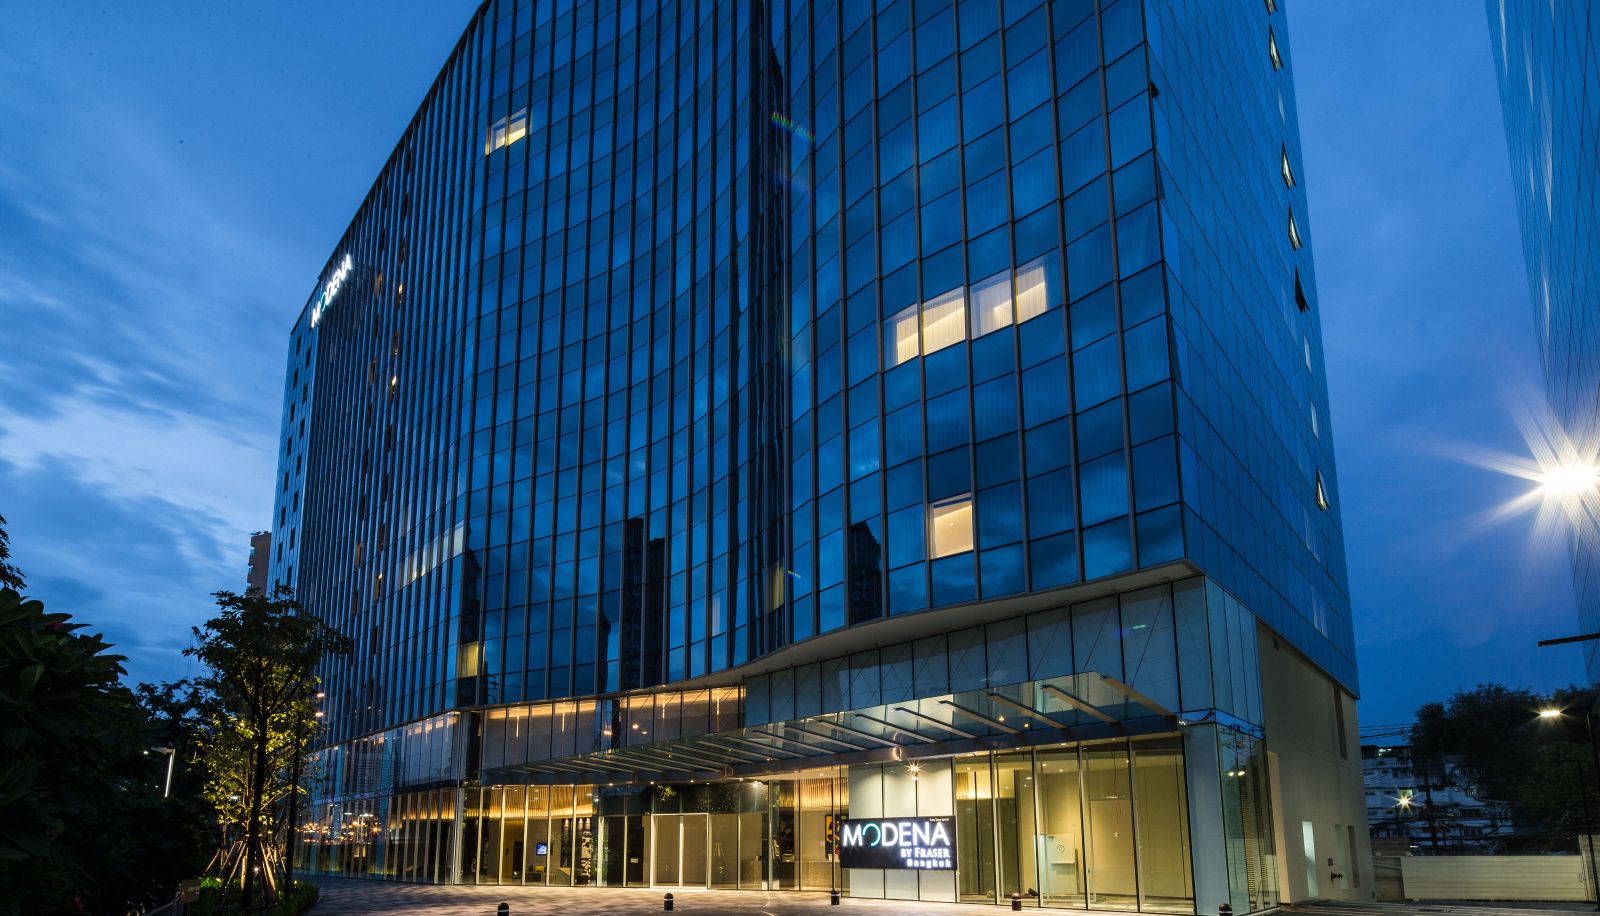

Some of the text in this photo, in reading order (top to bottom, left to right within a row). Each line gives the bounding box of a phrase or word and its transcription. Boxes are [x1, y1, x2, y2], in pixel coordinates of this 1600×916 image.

[311, 254, 351, 328] MODENA
[843, 822, 950, 847] MODENA
[901, 847, 950, 858] BY FRASER
[907, 859, 951, 868] Bangkok
